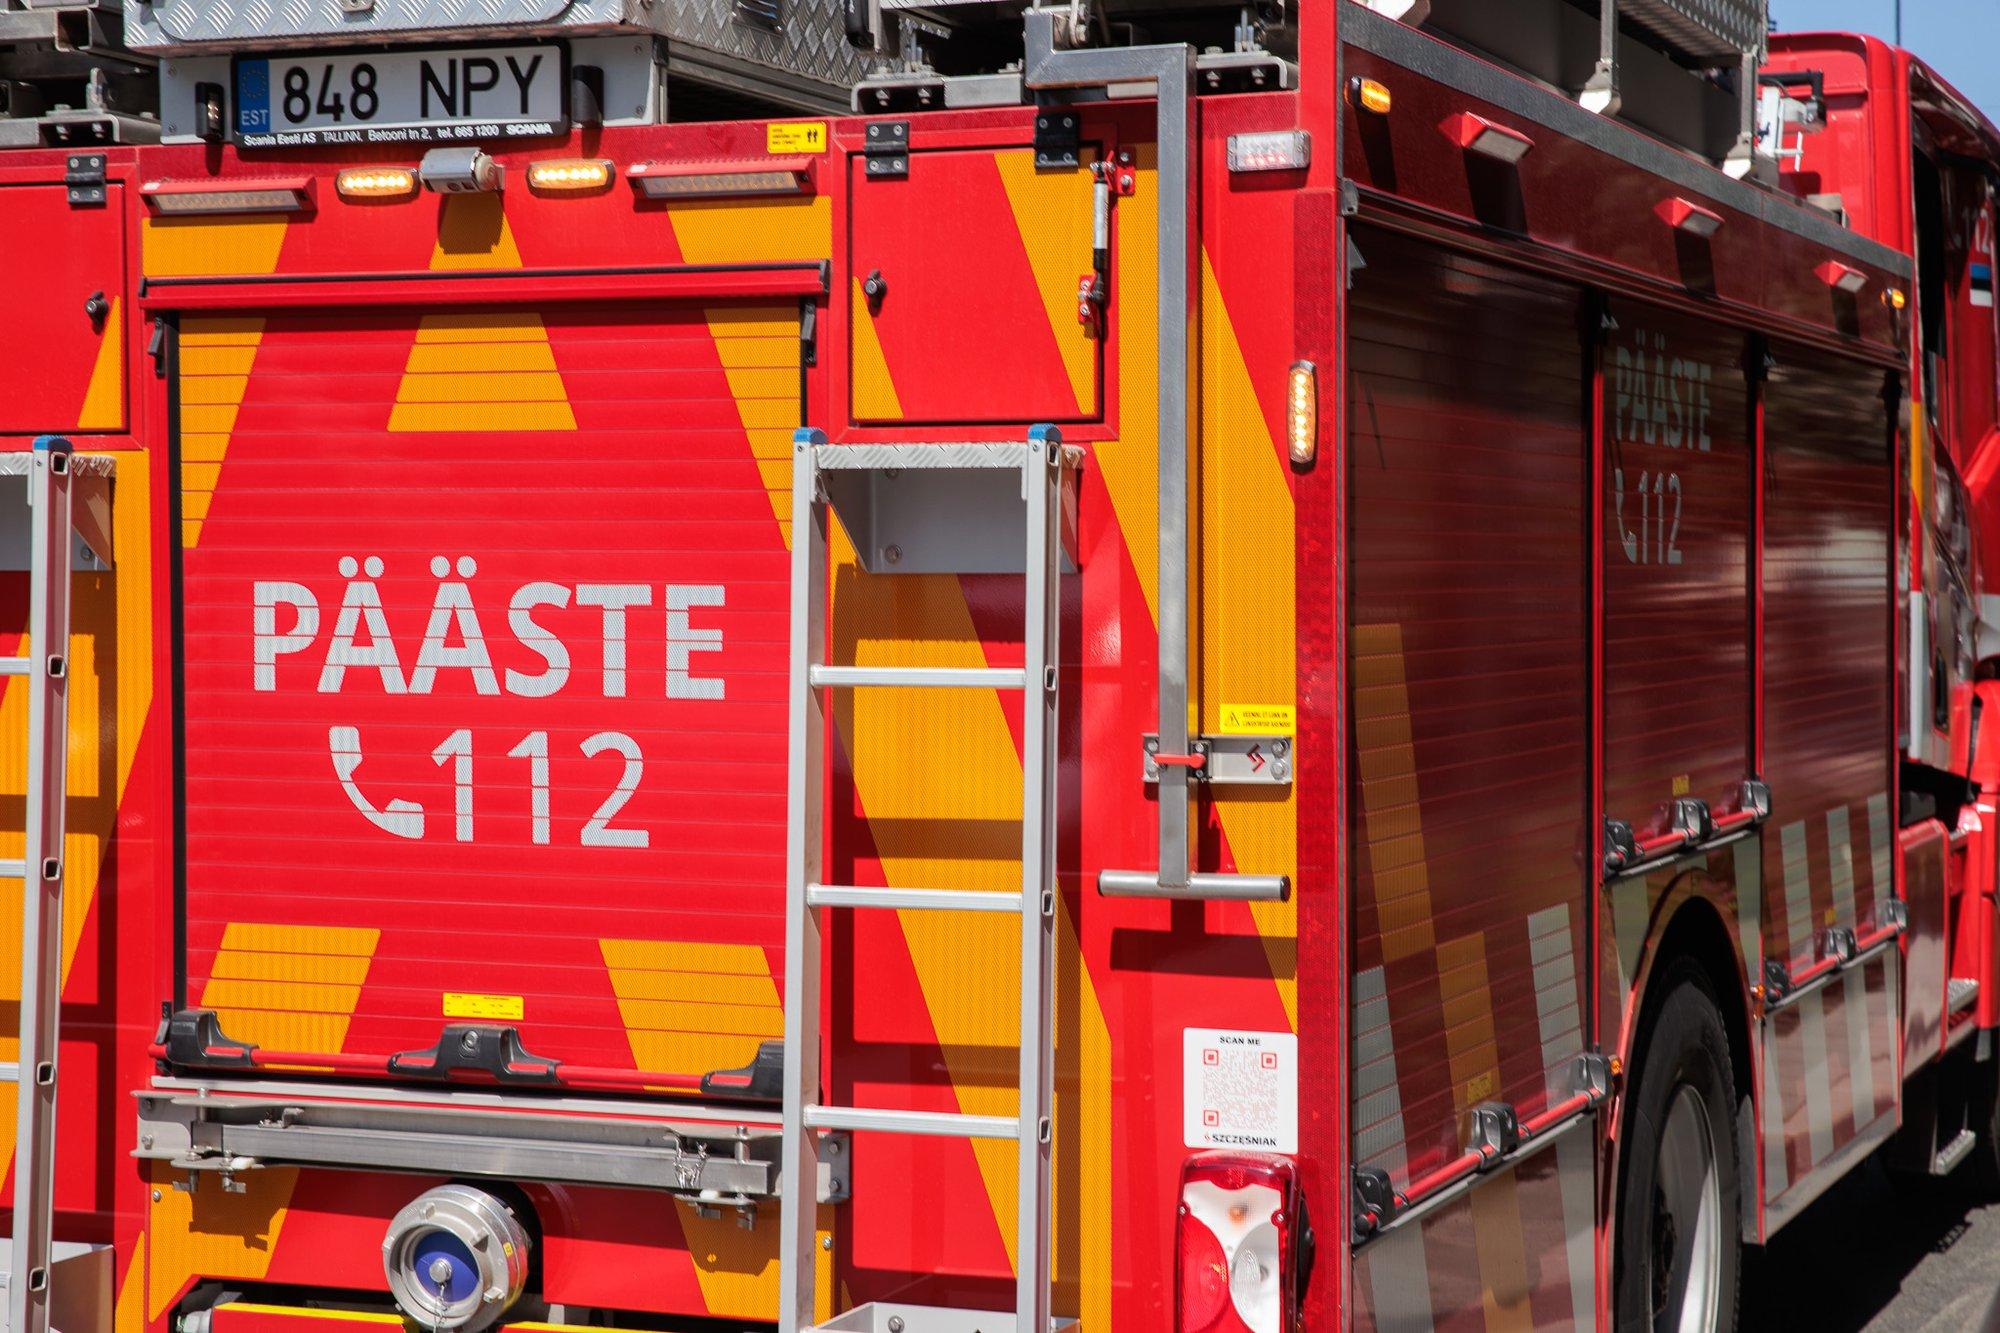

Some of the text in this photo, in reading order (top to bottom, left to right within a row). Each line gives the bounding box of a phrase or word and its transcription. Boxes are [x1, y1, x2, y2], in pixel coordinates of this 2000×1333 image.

[241, 109, 268, 126] EST
[283, 54, 543, 124] 848 NPY
[244, 133, 277, 147] Scania
[277, 132, 301, 146] Eesti
[301, 132, 317, 144] AS
[368, 128, 407, 142] Betooni
[436, 126, 453, 139] tel.
[475, 123, 500, 137] 1200
[506, 123, 553, 136] SCANIA
[1616, 328, 1711, 452] PÄÄSTE
[1638, 470, 1682, 564] 112
[254, 555, 726, 700] PÄÄSTE
[430, 728, 650, 849] 112
[1219, 1035, 1262, 1047] SCAN ME
[1212, 1132, 1278, 1146] SZCZĘŚNIAK
